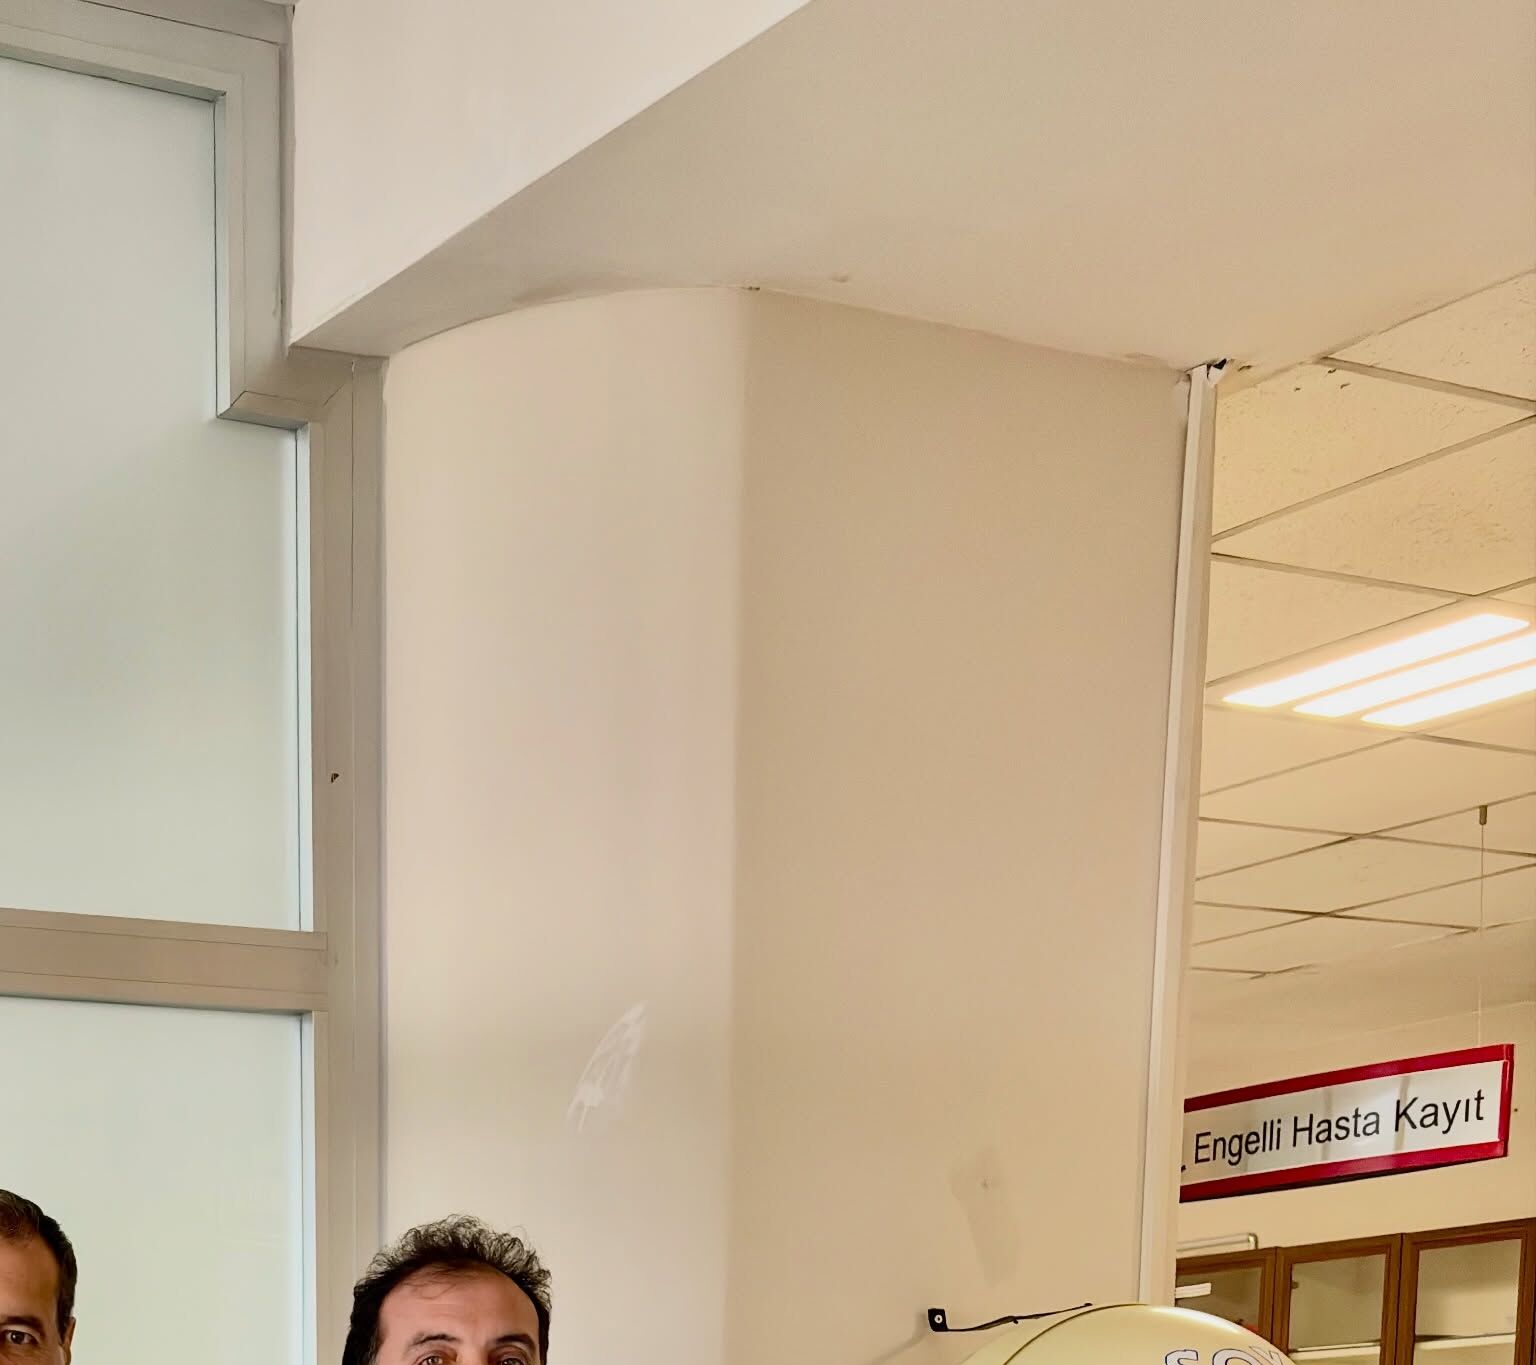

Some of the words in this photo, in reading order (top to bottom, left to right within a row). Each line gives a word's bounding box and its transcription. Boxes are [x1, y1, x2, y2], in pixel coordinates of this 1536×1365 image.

[1194, 1119, 1281, 1166] Engelli
[1293, 1107, 1380, 1147] Hasta
[1394, 1089, 1485, 1134] Kayıt
